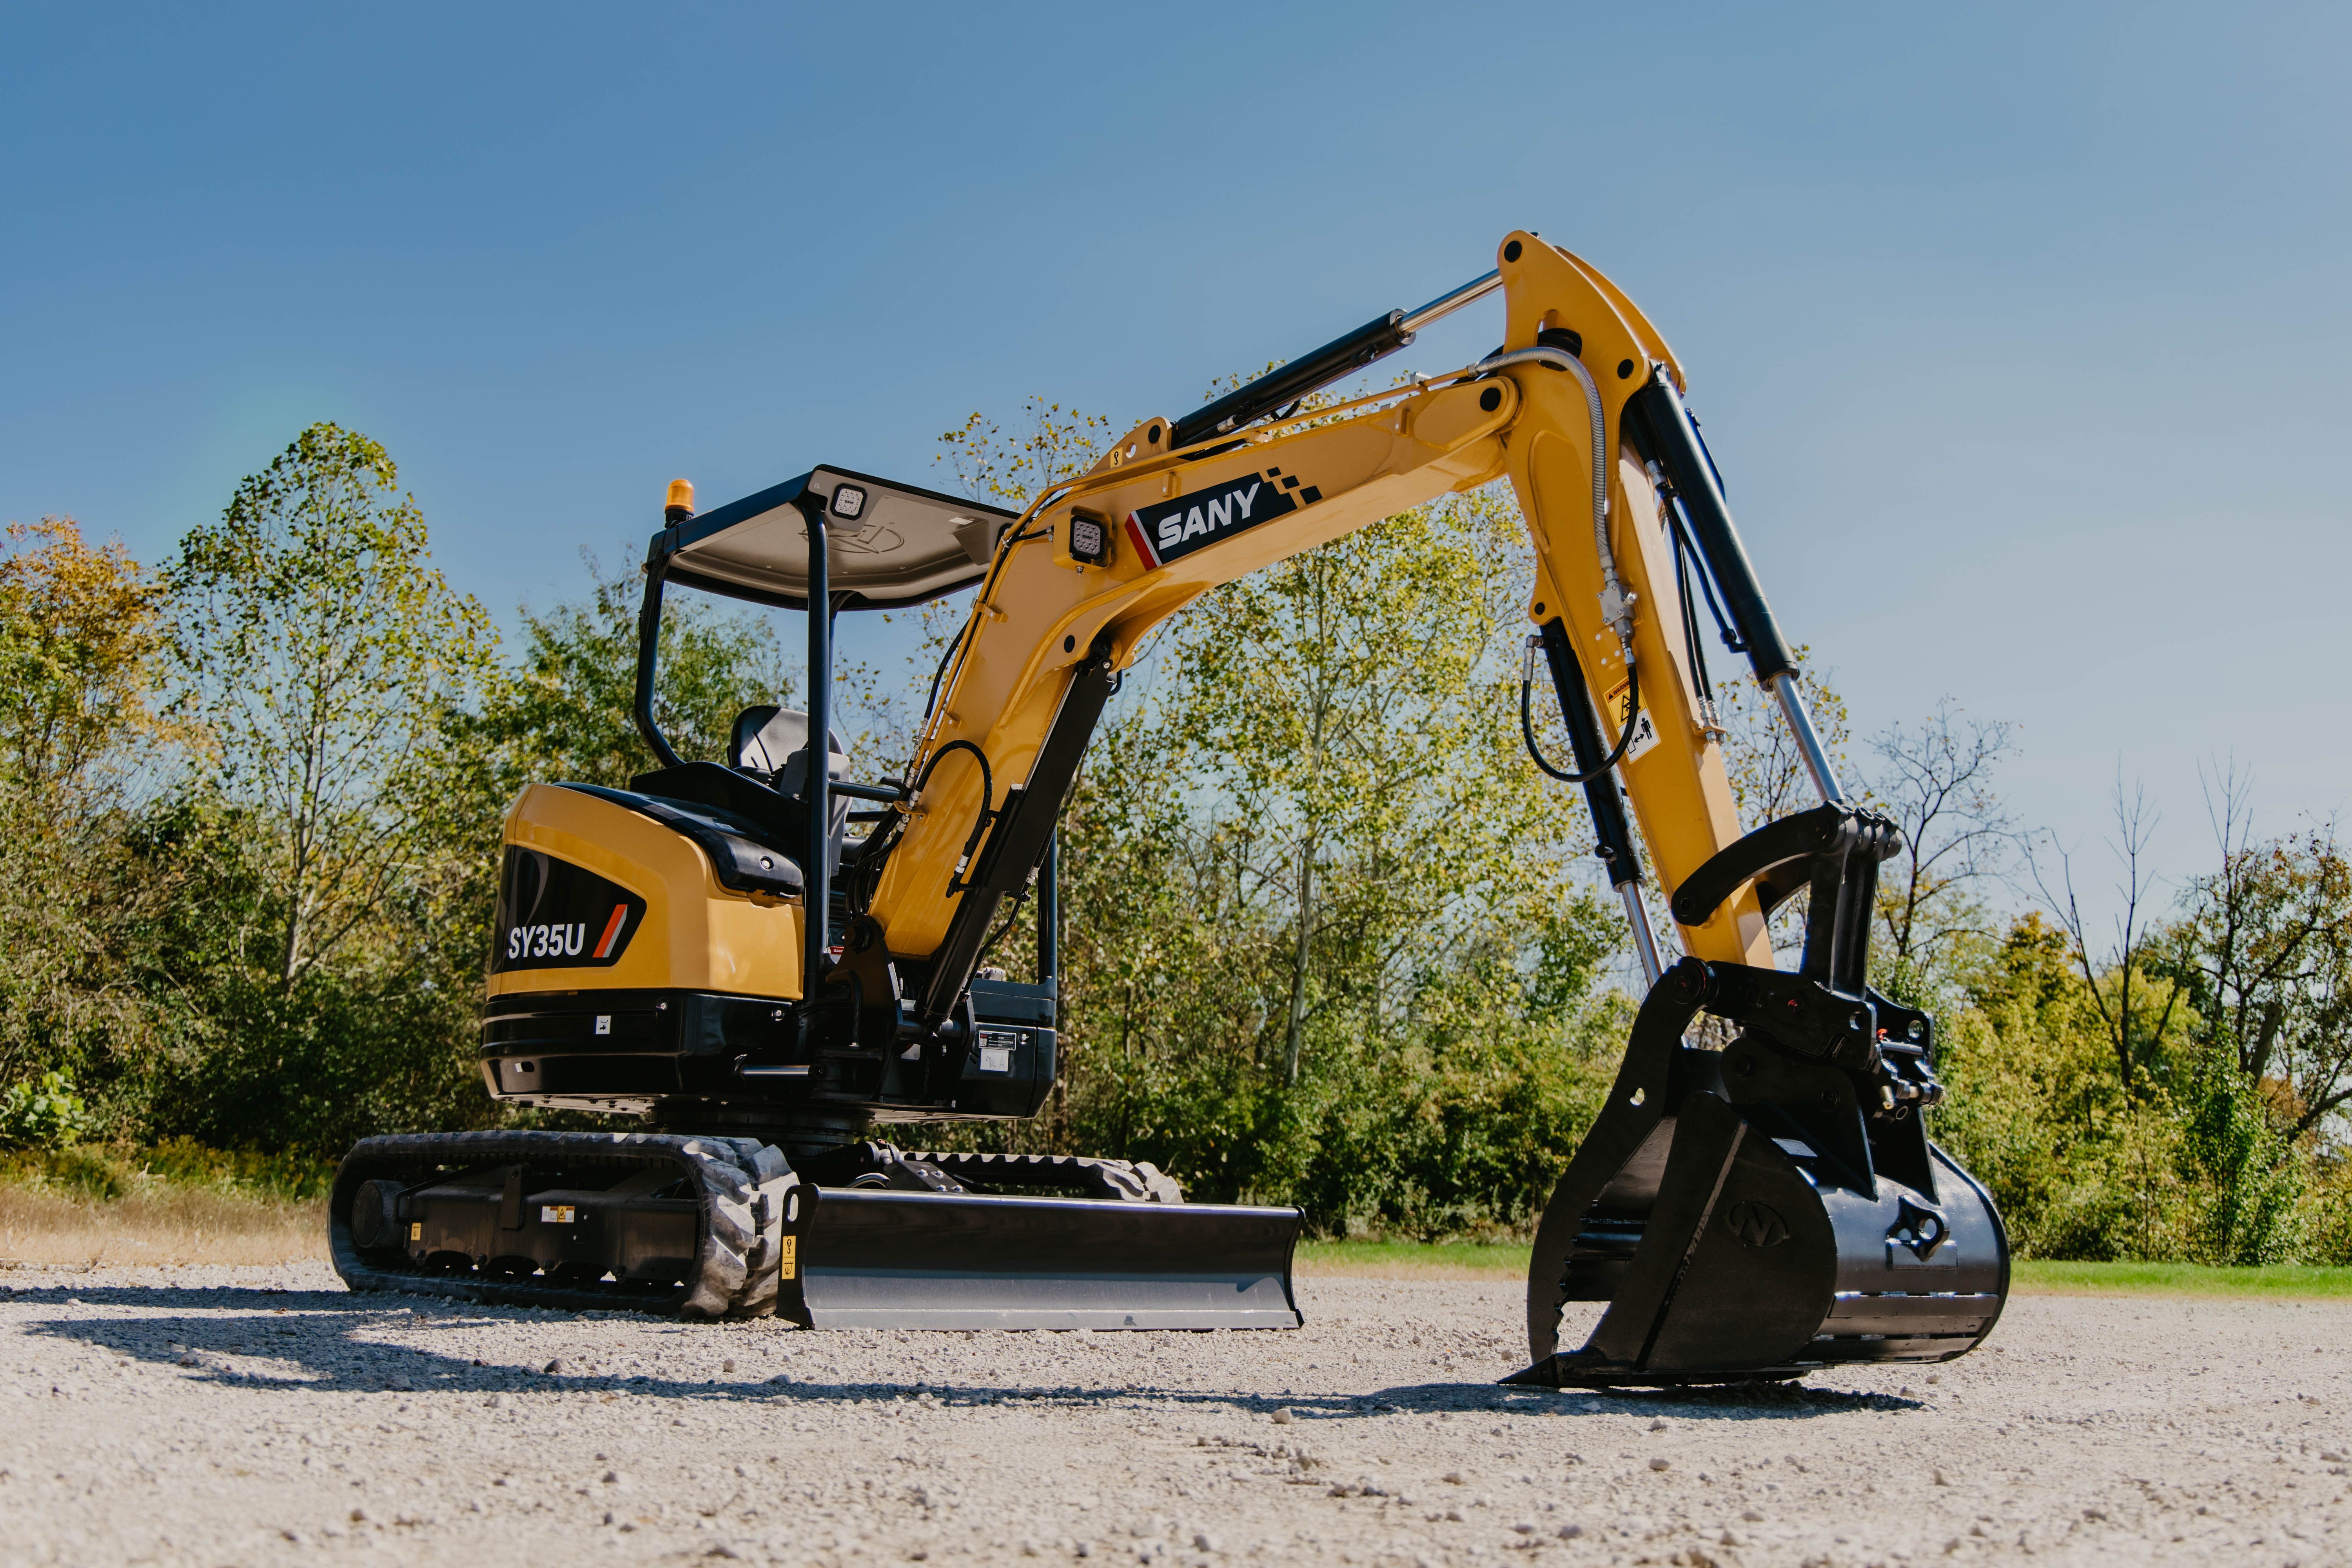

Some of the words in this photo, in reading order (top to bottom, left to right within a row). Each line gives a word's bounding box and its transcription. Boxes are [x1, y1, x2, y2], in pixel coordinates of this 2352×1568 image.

[1158, 482, 1260, 550] SANY
[1613, 681, 1630, 695] WARNI
[509, 923, 585, 959] SY35U
